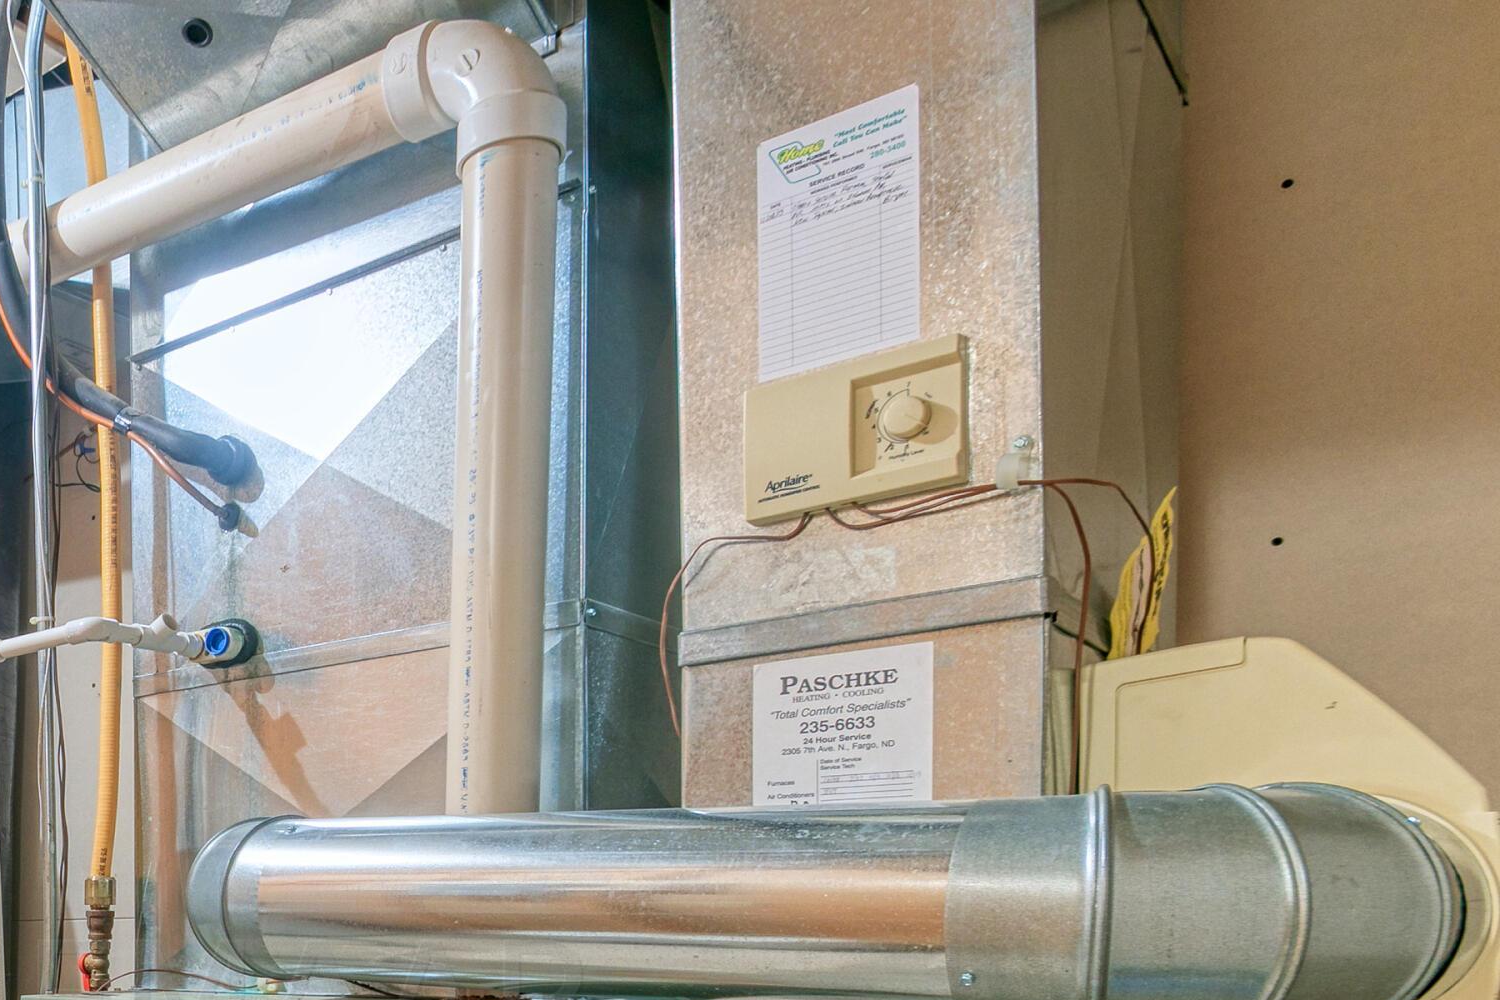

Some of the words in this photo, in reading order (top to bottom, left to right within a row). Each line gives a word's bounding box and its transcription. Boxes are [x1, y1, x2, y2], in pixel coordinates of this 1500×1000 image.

[858, 107, 905, 130] Comfortable
[777, 139, 825, 164] Home
[833, 137, 849, 148] Call
[837, 163, 866, 178] RECORD
[764, 474, 809, 493] Aprilaire
[779, 668, 899, 696] PASCHKE
[792, 692, 831, 704] HEATING
[842, 686, 885, 699] COOLING
[801, 702, 844, 719] Comfort
[799, 715, 876, 735] 235-6633
[803, 736, 814, 745] 24
[815, 735, 837, 745] Hour
[839, 732, 872, 742] Service
[852, 740, 879, 752] Fargo,
[881, 739, 896, 749] ND
